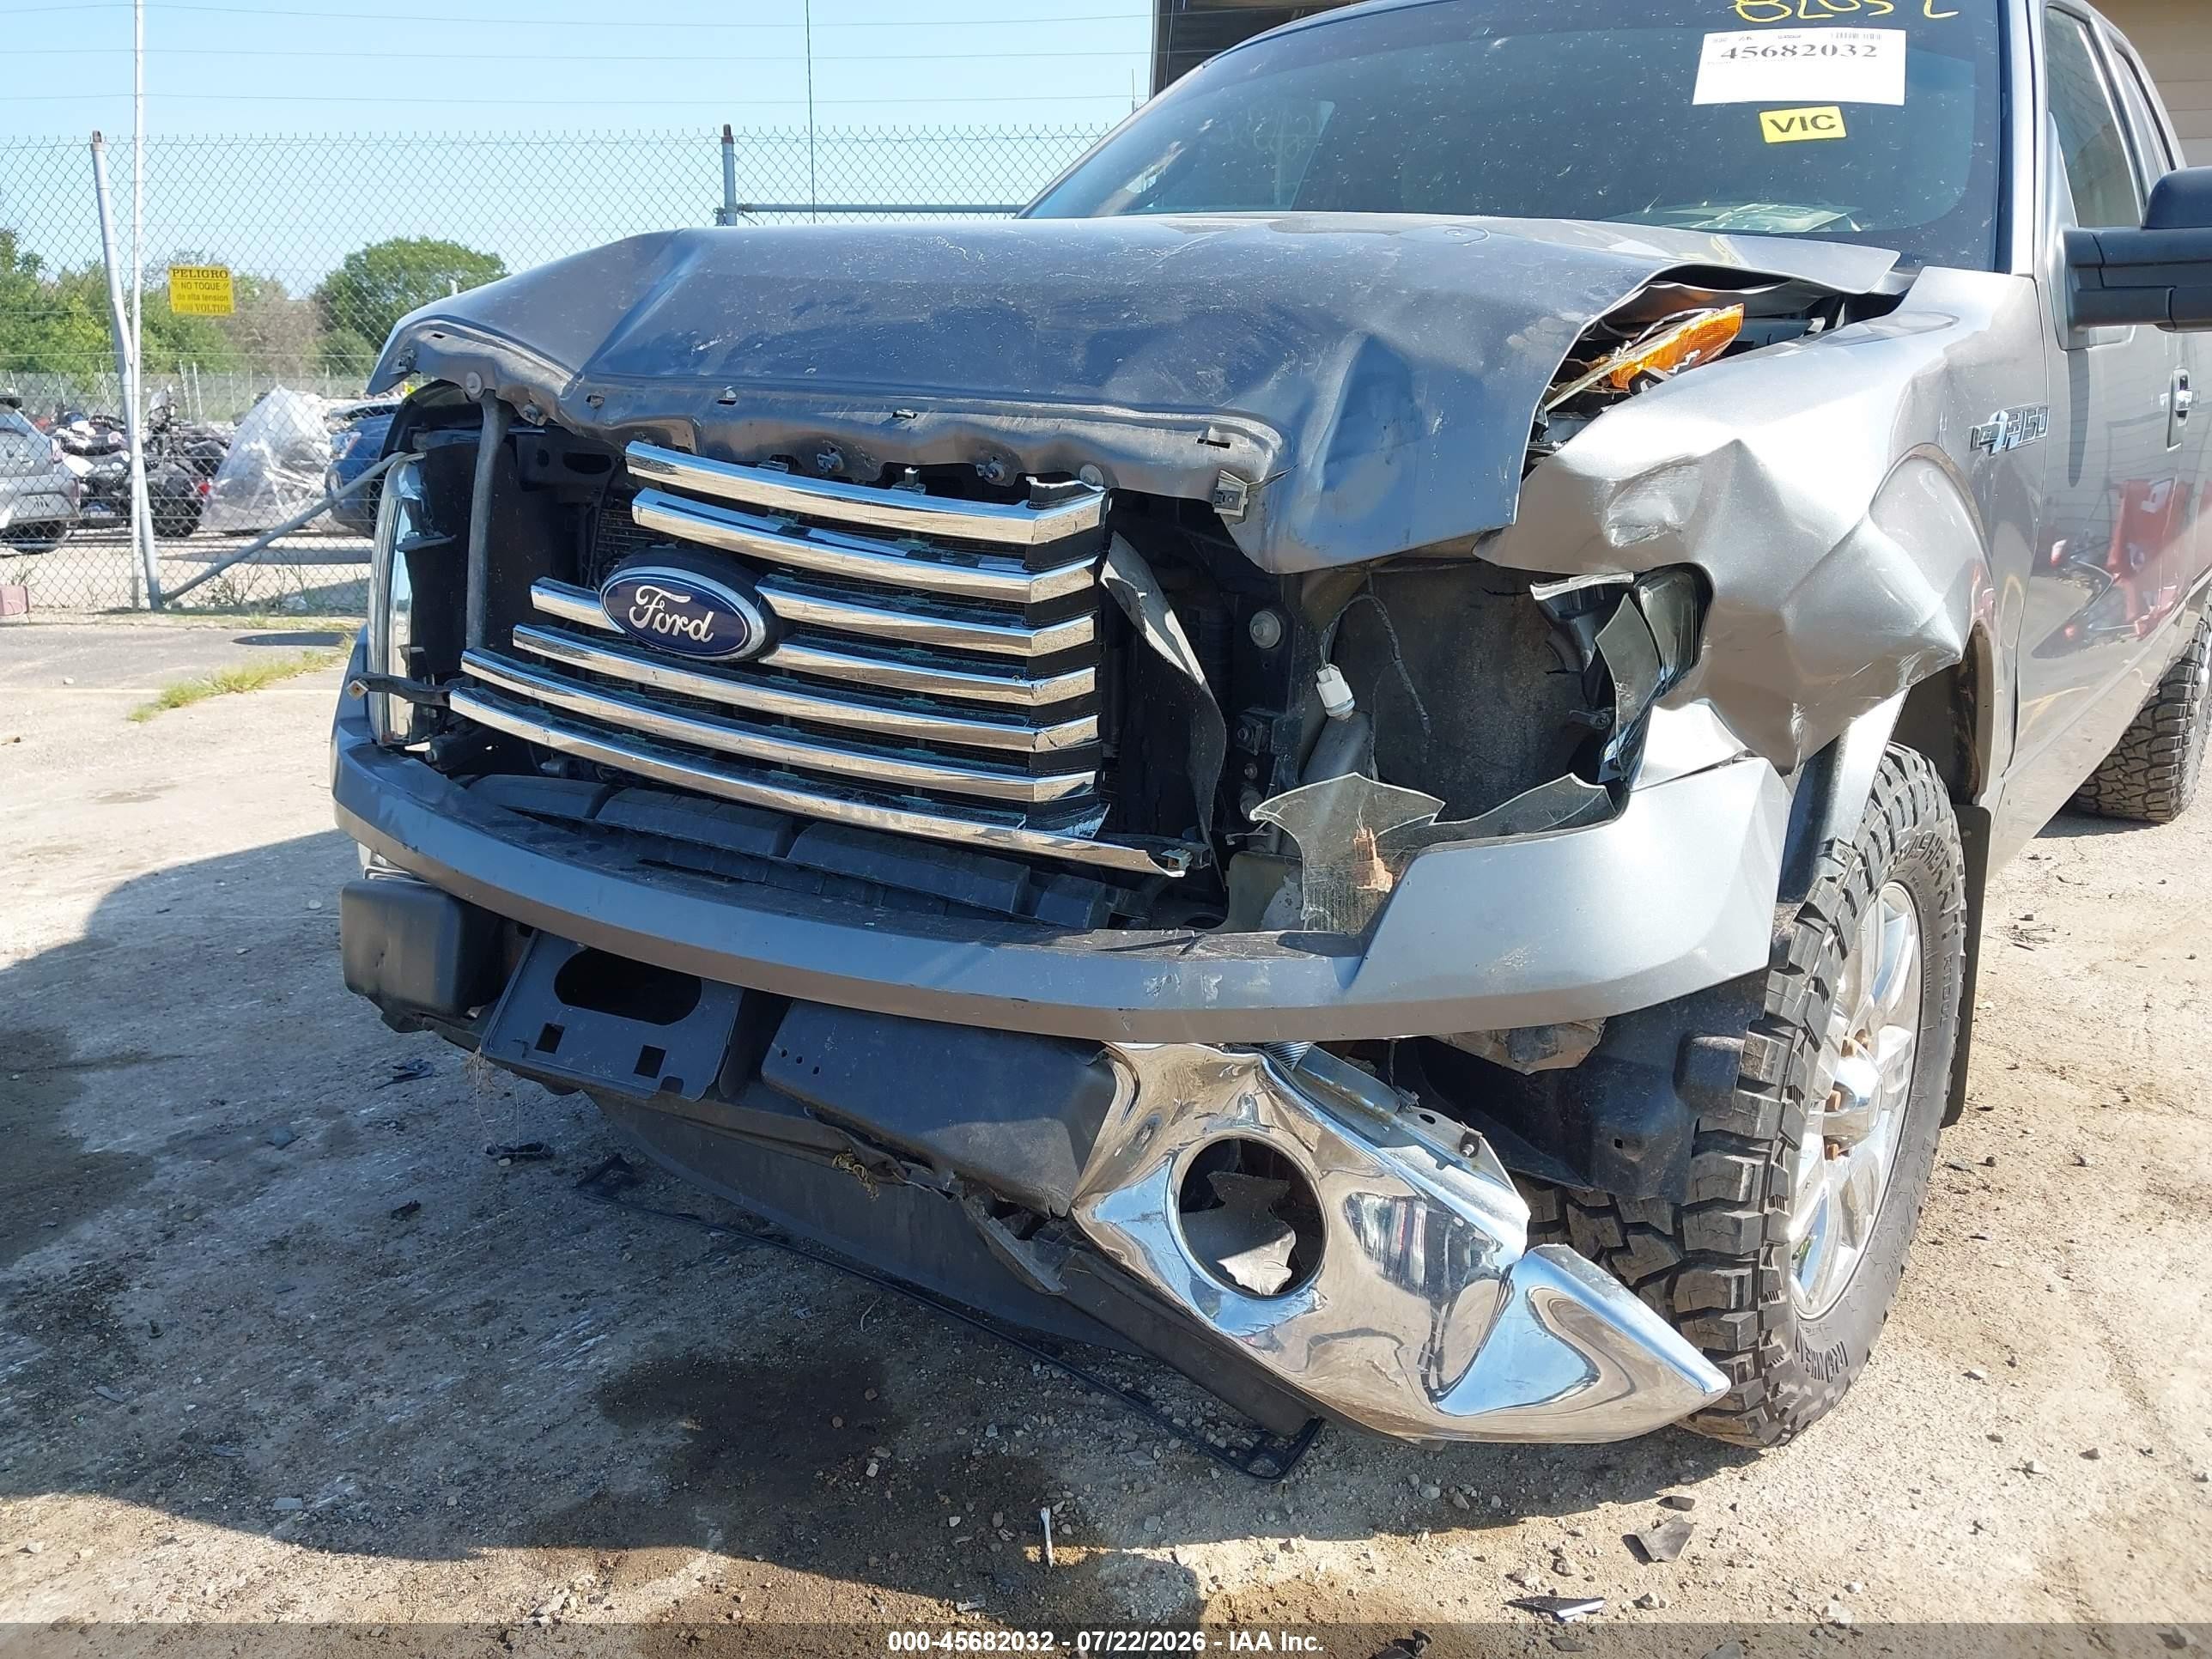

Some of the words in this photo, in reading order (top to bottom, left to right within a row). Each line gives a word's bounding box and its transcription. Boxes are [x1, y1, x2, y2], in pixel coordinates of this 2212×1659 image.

[1720, 44, 1878, 59] 45682032
[1769, 114, 1836, 133] VIC
[173, 268, 228, 278] PELIGRO
[181, 282, 192, 290] NO
[194, 282, 221, 290] TOQUE
[629, 586, 714, 642] Ford
